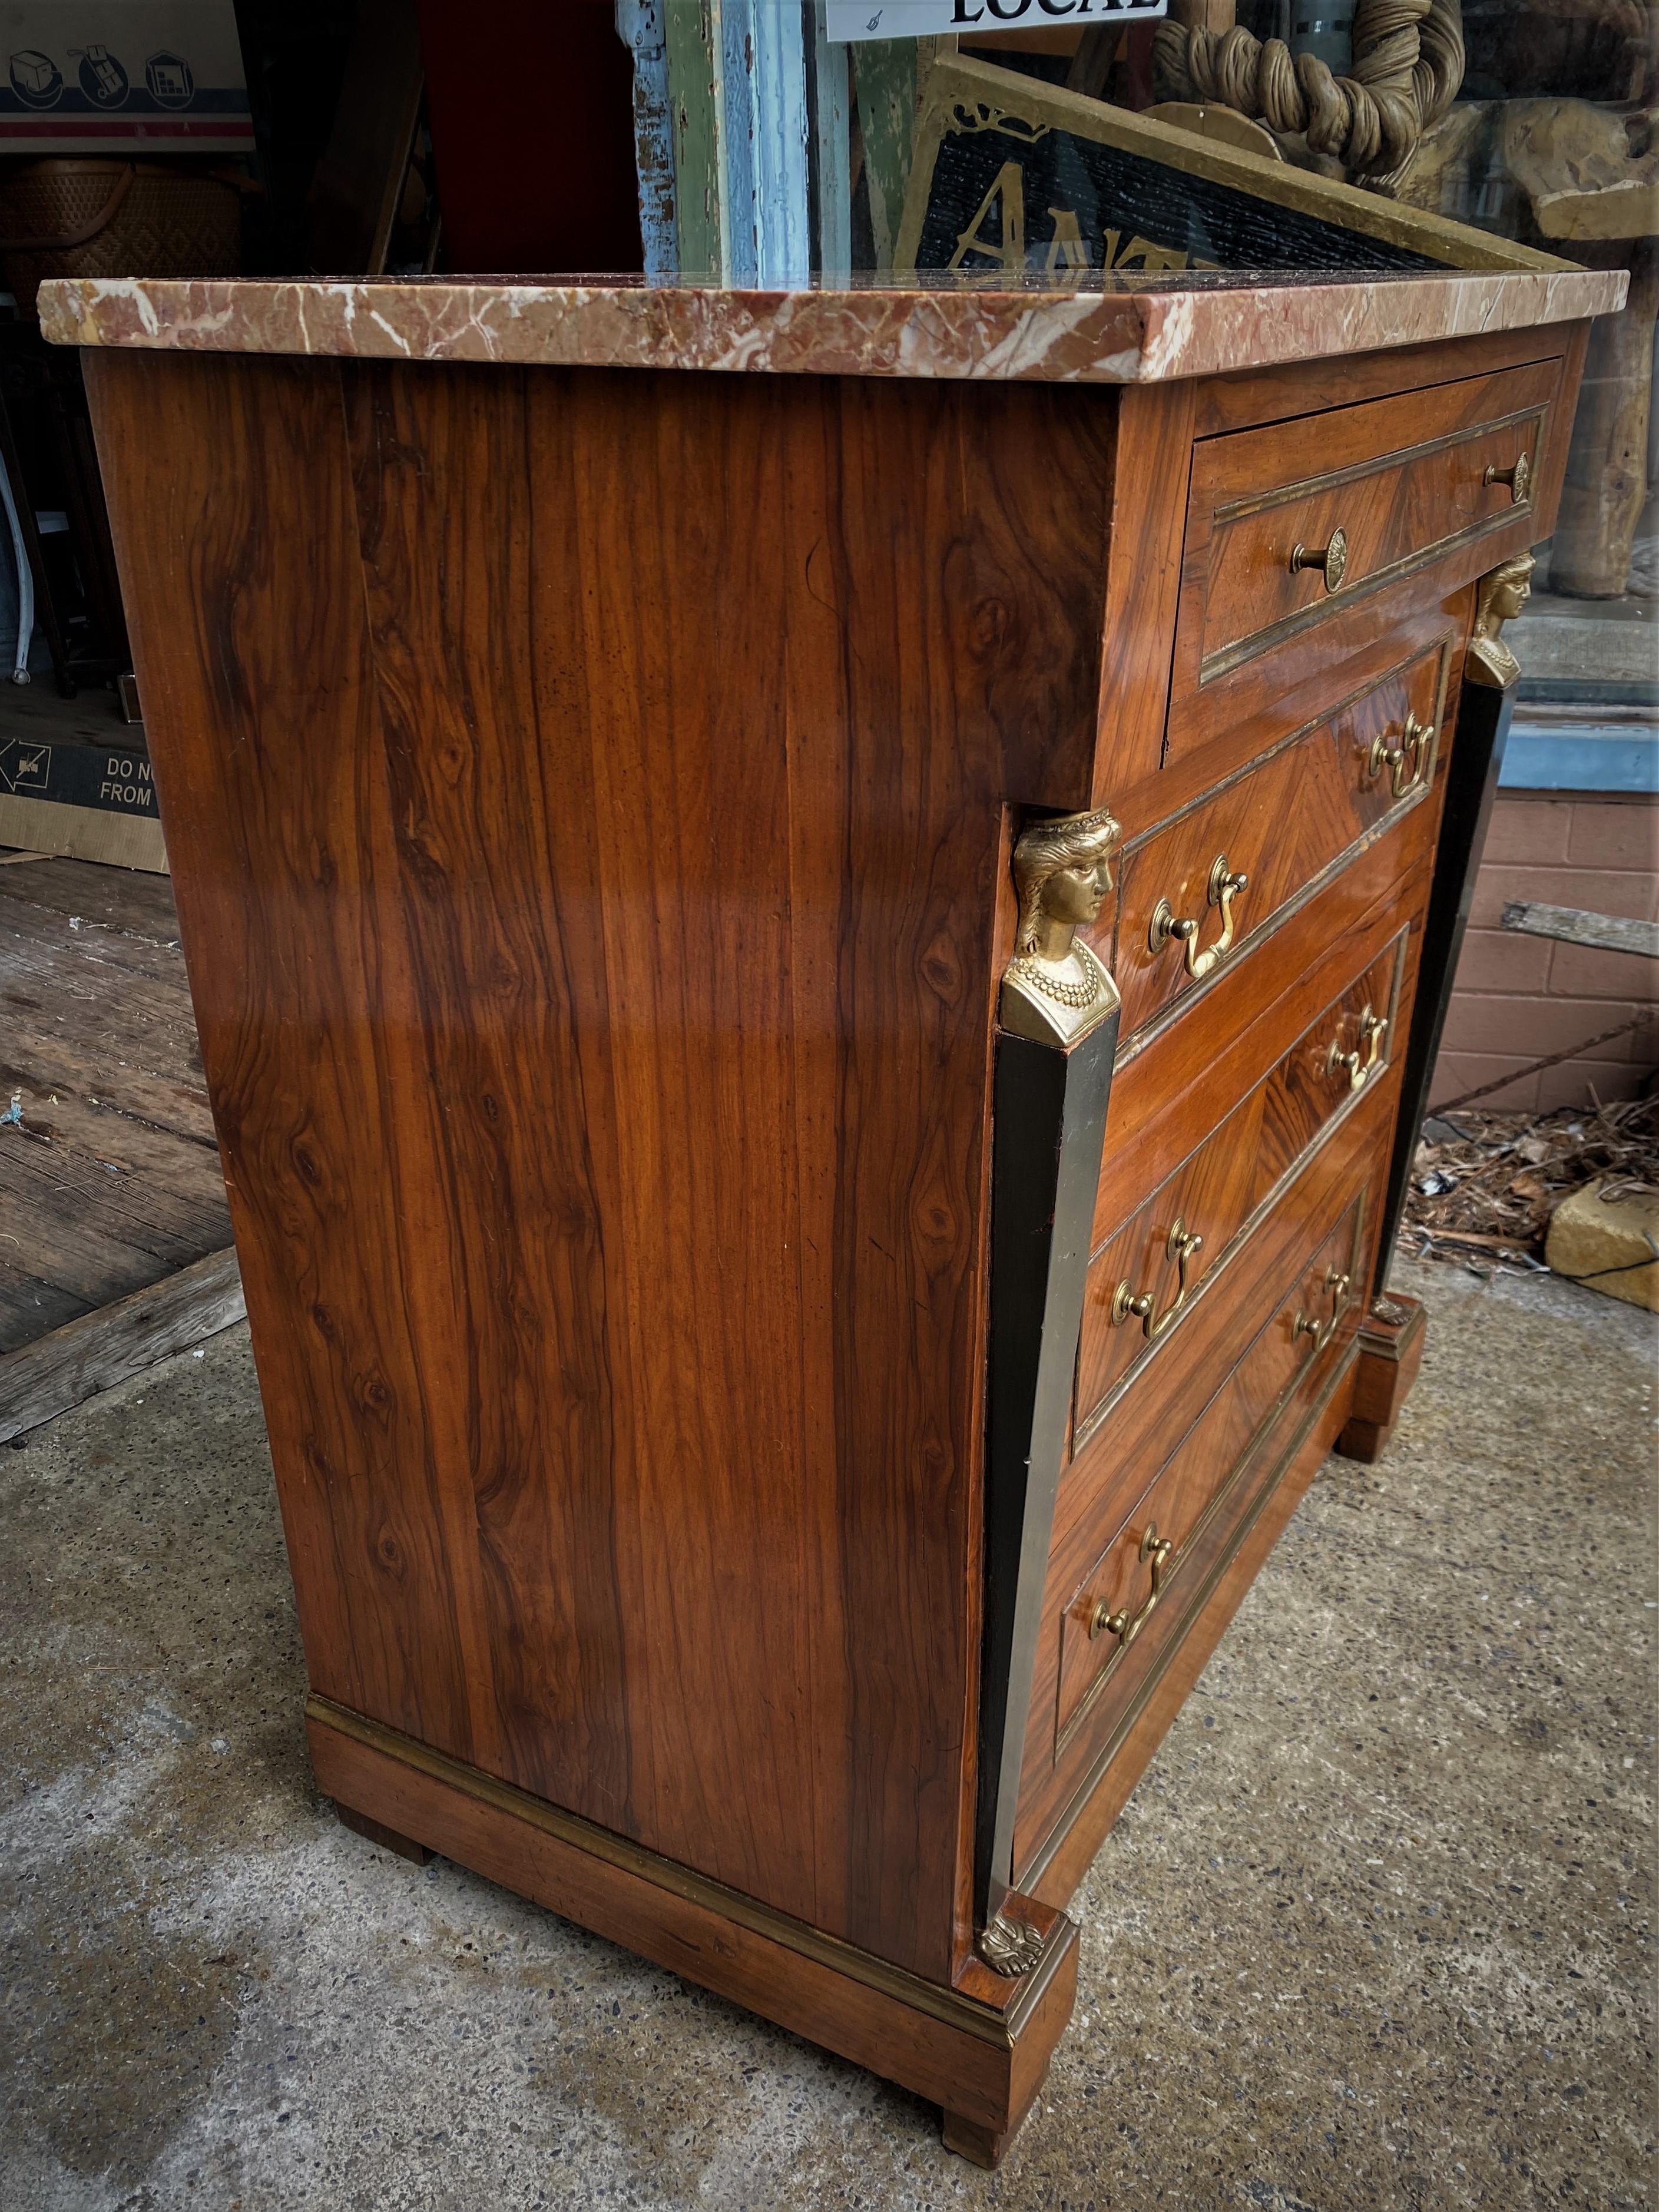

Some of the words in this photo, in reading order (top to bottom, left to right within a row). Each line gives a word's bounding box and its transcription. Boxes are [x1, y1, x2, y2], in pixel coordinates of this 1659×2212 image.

[107, 757, 133, 777] DO
[138, 763, 153, 780] N
[101, 782, 151, 806] FROM
